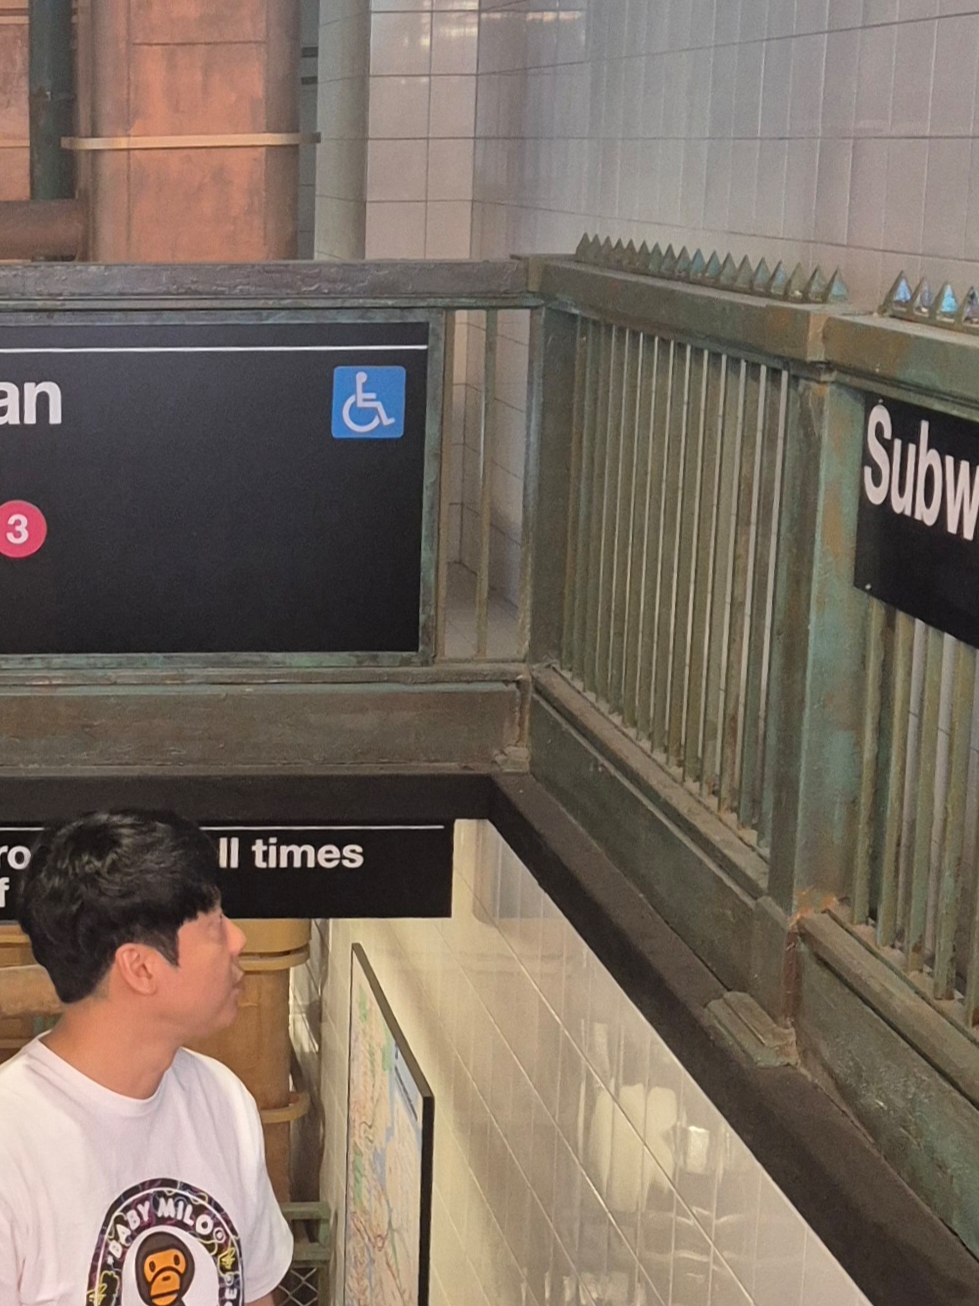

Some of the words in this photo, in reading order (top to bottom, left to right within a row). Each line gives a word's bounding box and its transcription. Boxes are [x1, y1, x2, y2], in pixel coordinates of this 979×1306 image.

[5, 513, 29, 545] 3
[218, 837, 240, 869] ll
[251, 836, 364, 869] times
[109, 1200, 151, 1259] BABY
